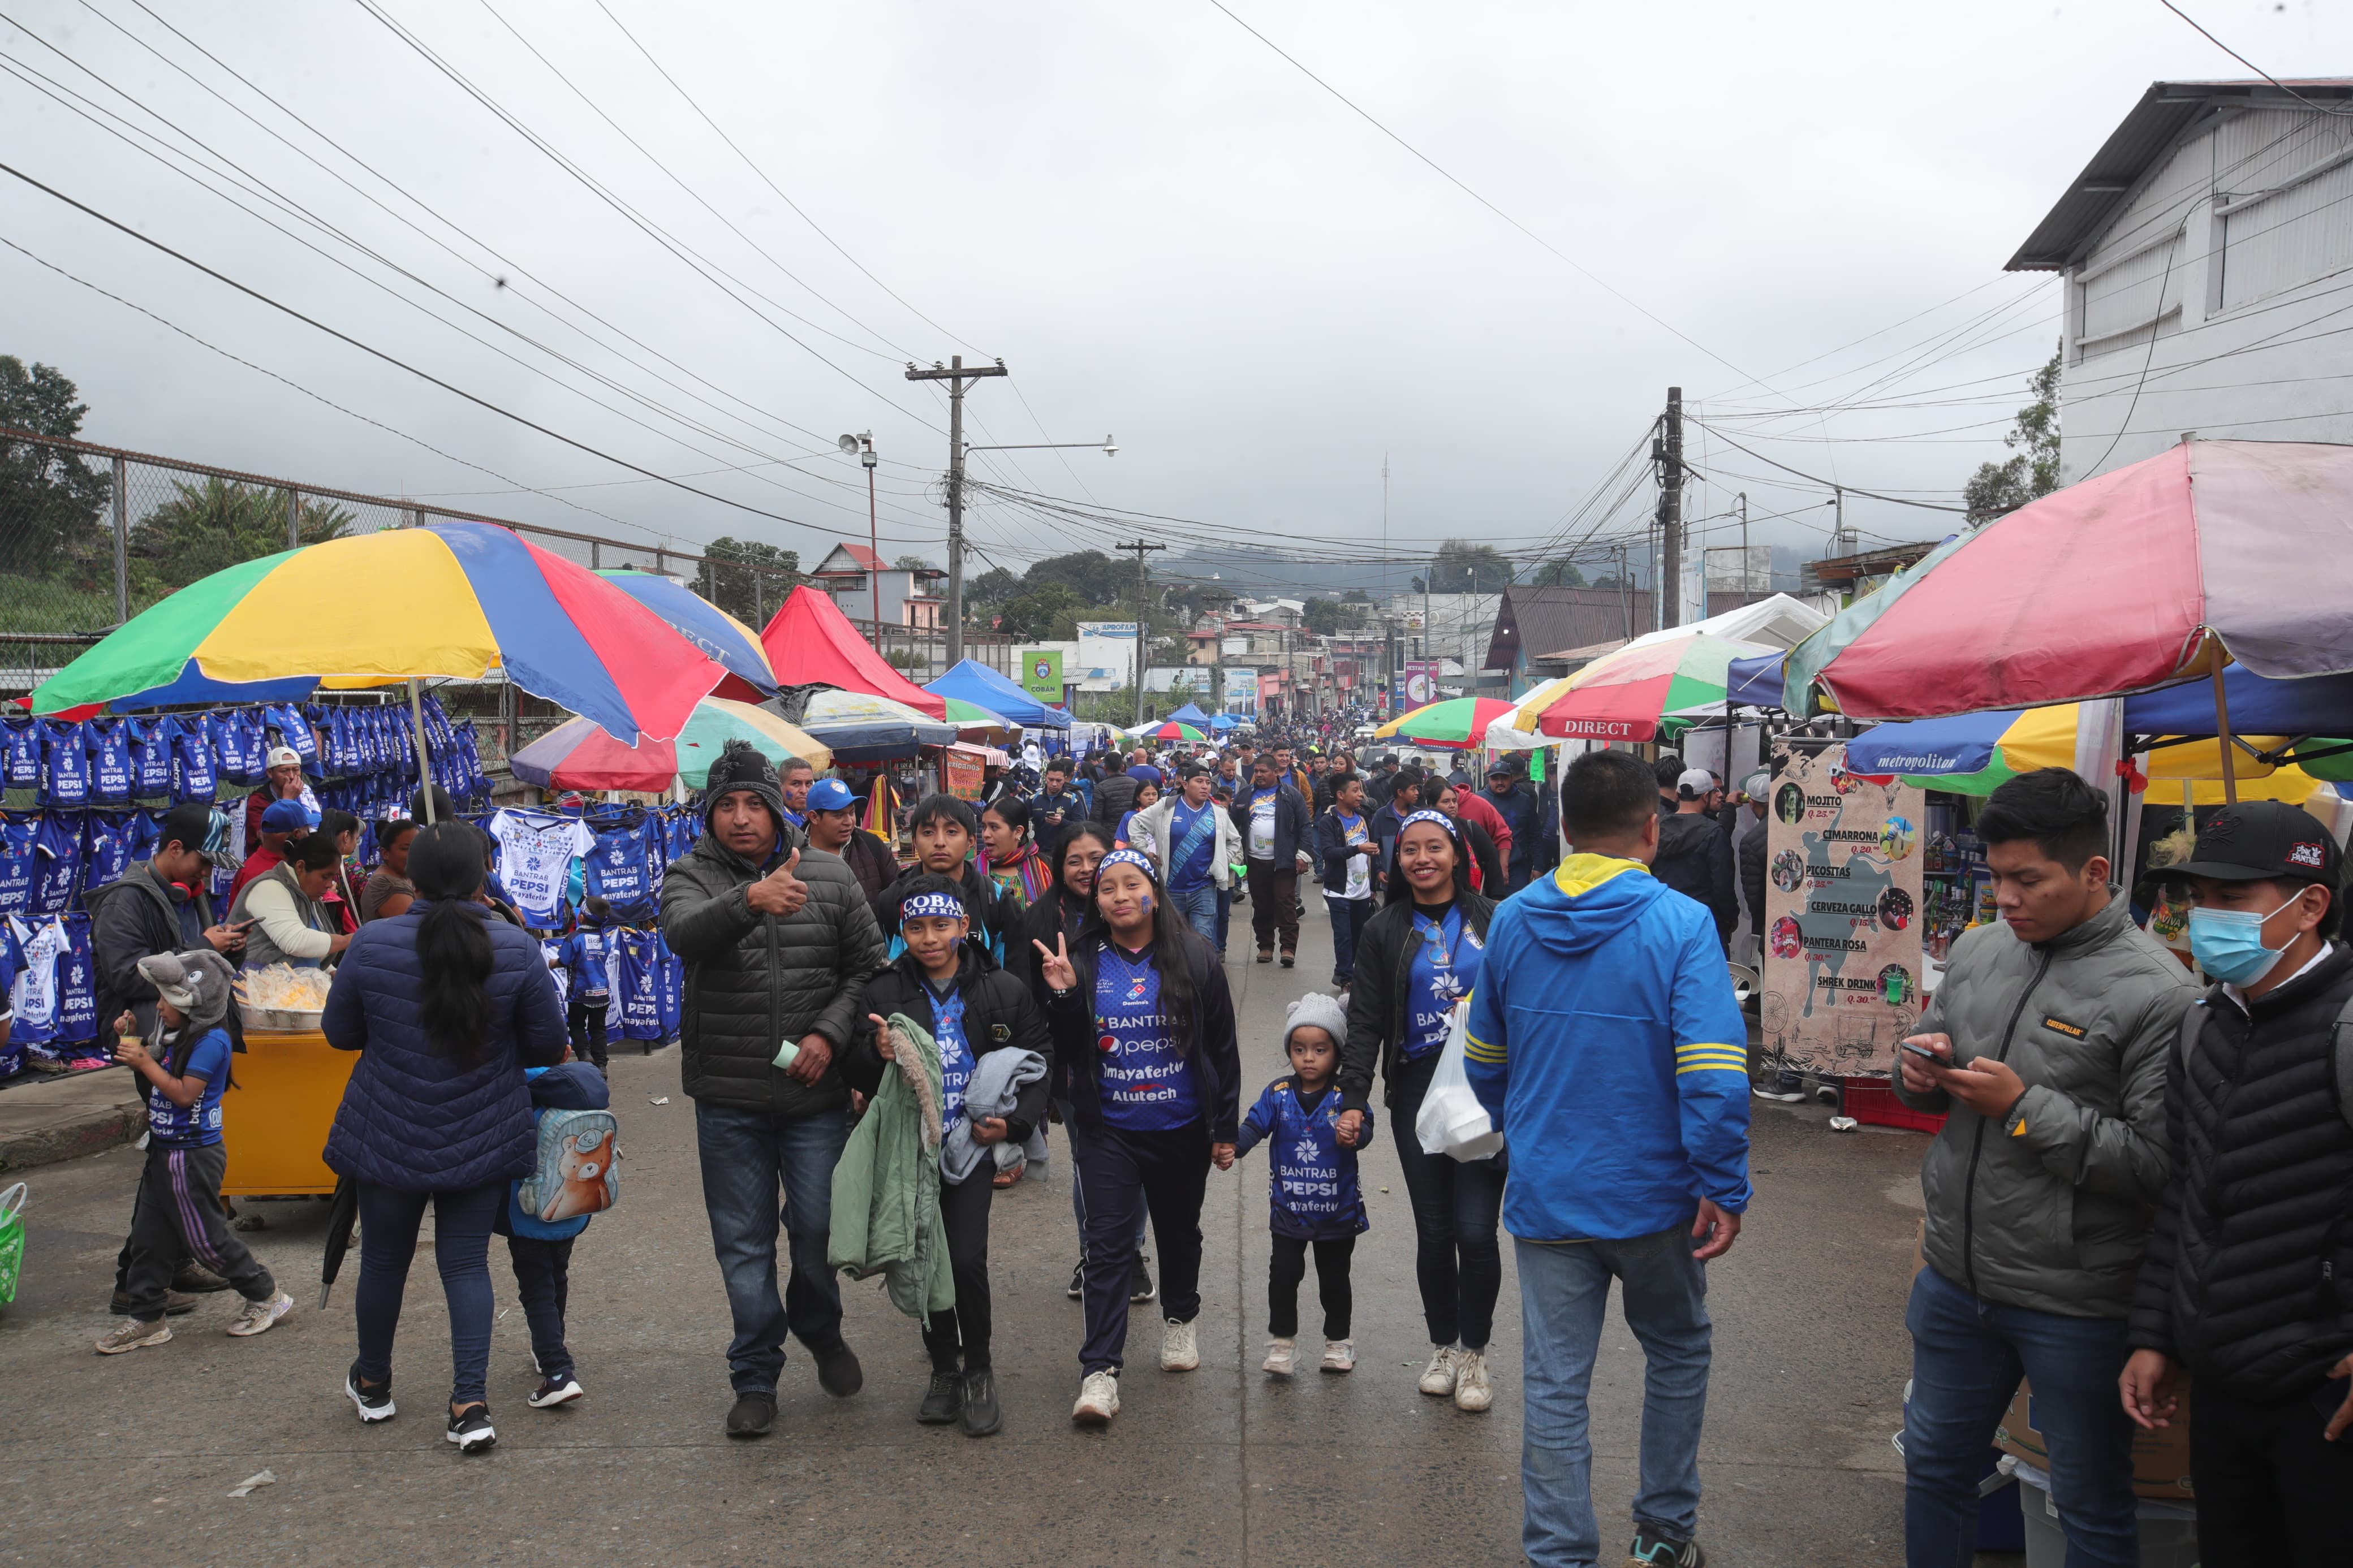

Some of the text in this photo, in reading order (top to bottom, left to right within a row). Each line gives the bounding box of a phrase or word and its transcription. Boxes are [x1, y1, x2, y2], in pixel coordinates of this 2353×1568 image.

[1565, 721, 1632, 736] DIRECT
[947, 761, 980, 771] exicanos
[1877, 754, 1956, 771] metropolitan
[101, 775, 126, 784] PEPSI
[173, 757, 181, 791] betcris
[58, 780, 83, 789] PEPSI
[953, 779, 975, 787] pastor
[1807, 796, 1842, 806] MOJITO
[1822, 830, 1878, 841] CIMARRONA
[514, 870, 549, 882] BANTRAB
[601, 866, 637, 877] BANTRAB
[1806, 865, 1851, 877] PICOSITAS
[510, 878, 549, 893] PEPSI
[558, 868, 571, 899] betcris
[602, 876, 639, 889] PEPSI
[1811, 901, 1877, 915] CERVEZA GALLO
[2162, 914, 2181, 927] VIVA
[1803, 936, 1867, 950] PANTERA ROSA
[1817, 976, 1877, 990] SHREK DRINK
[996, 1029, 1002, 1038] 7
[2046, 1018, 2081, 1036] CATERPILLAR
[1113, 1087, 1177, 1102] Alutech
[1280, 1165, 1337, 1179] BANTRAB
[1282, 1180, 1338, 1196] PEPSI
